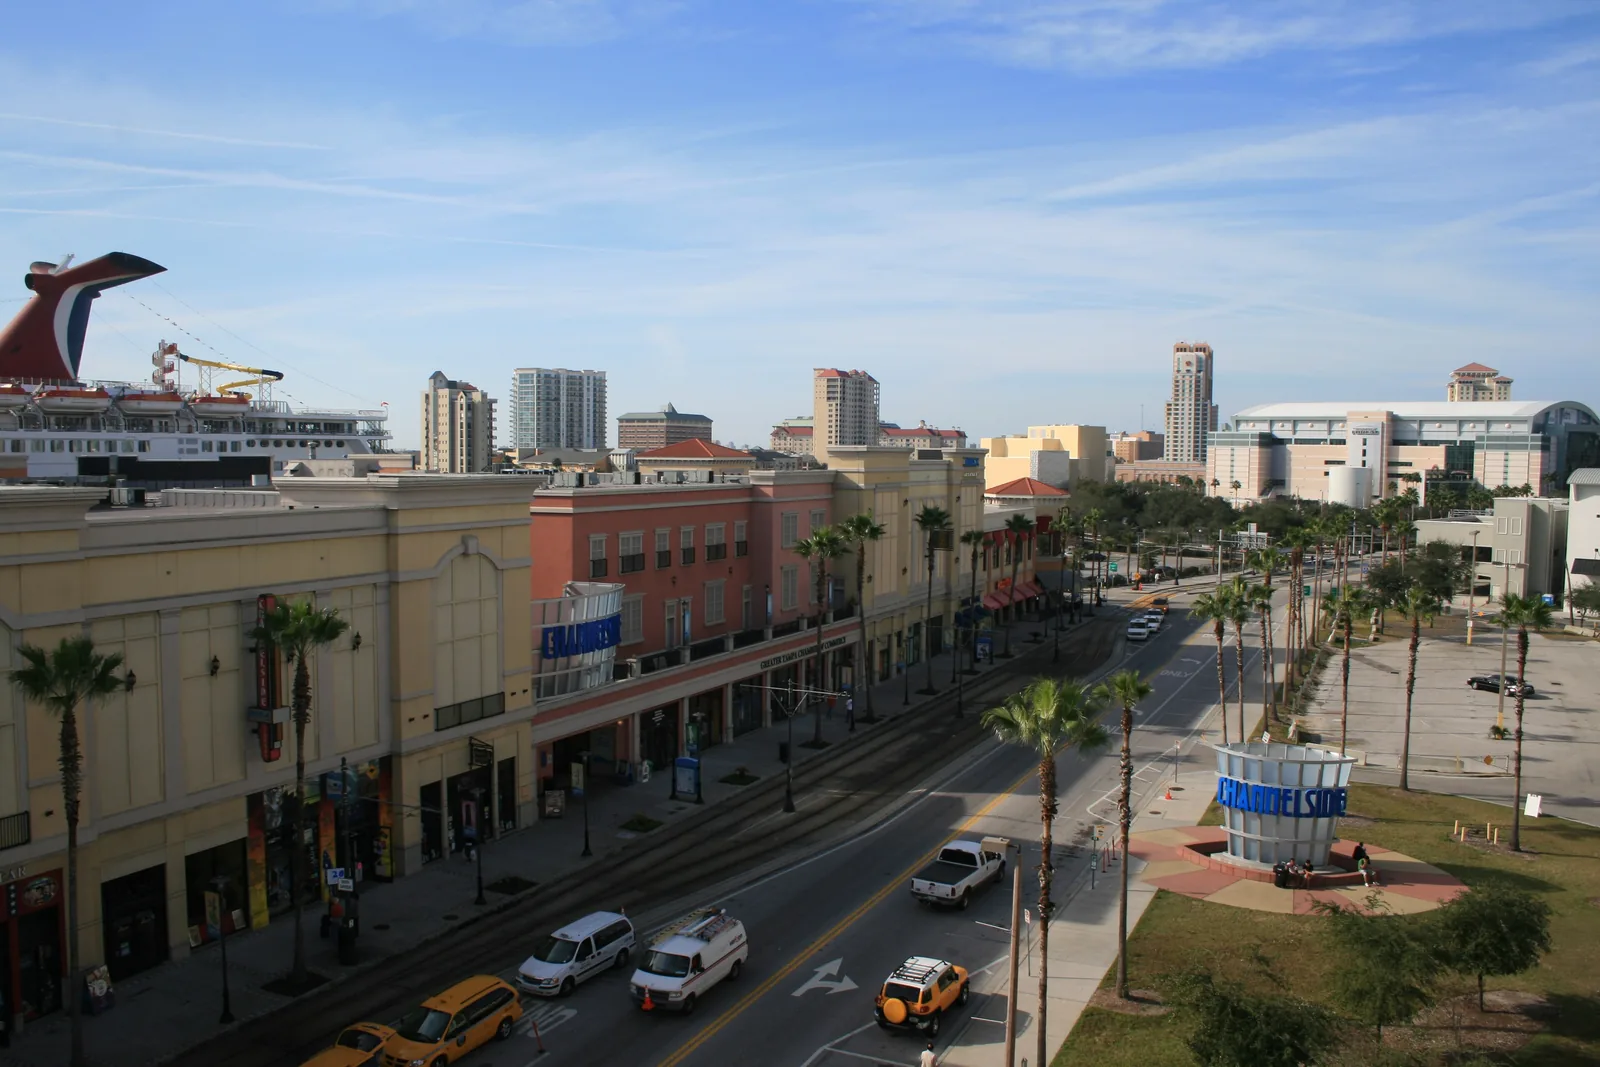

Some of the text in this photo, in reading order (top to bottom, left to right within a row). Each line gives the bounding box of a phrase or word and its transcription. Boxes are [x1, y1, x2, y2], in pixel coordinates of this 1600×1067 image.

[258, 599, 268, 707] CHAELSIDE
[761, 656, 782, 669] GREATER
[782, 652, 797, 662] TAMPA
[797, 645, 819, 656] CHAM
[1160, 669, 1192, 678] ONLY
[1217, 776, 1347, 818] CHANNELSIDE
